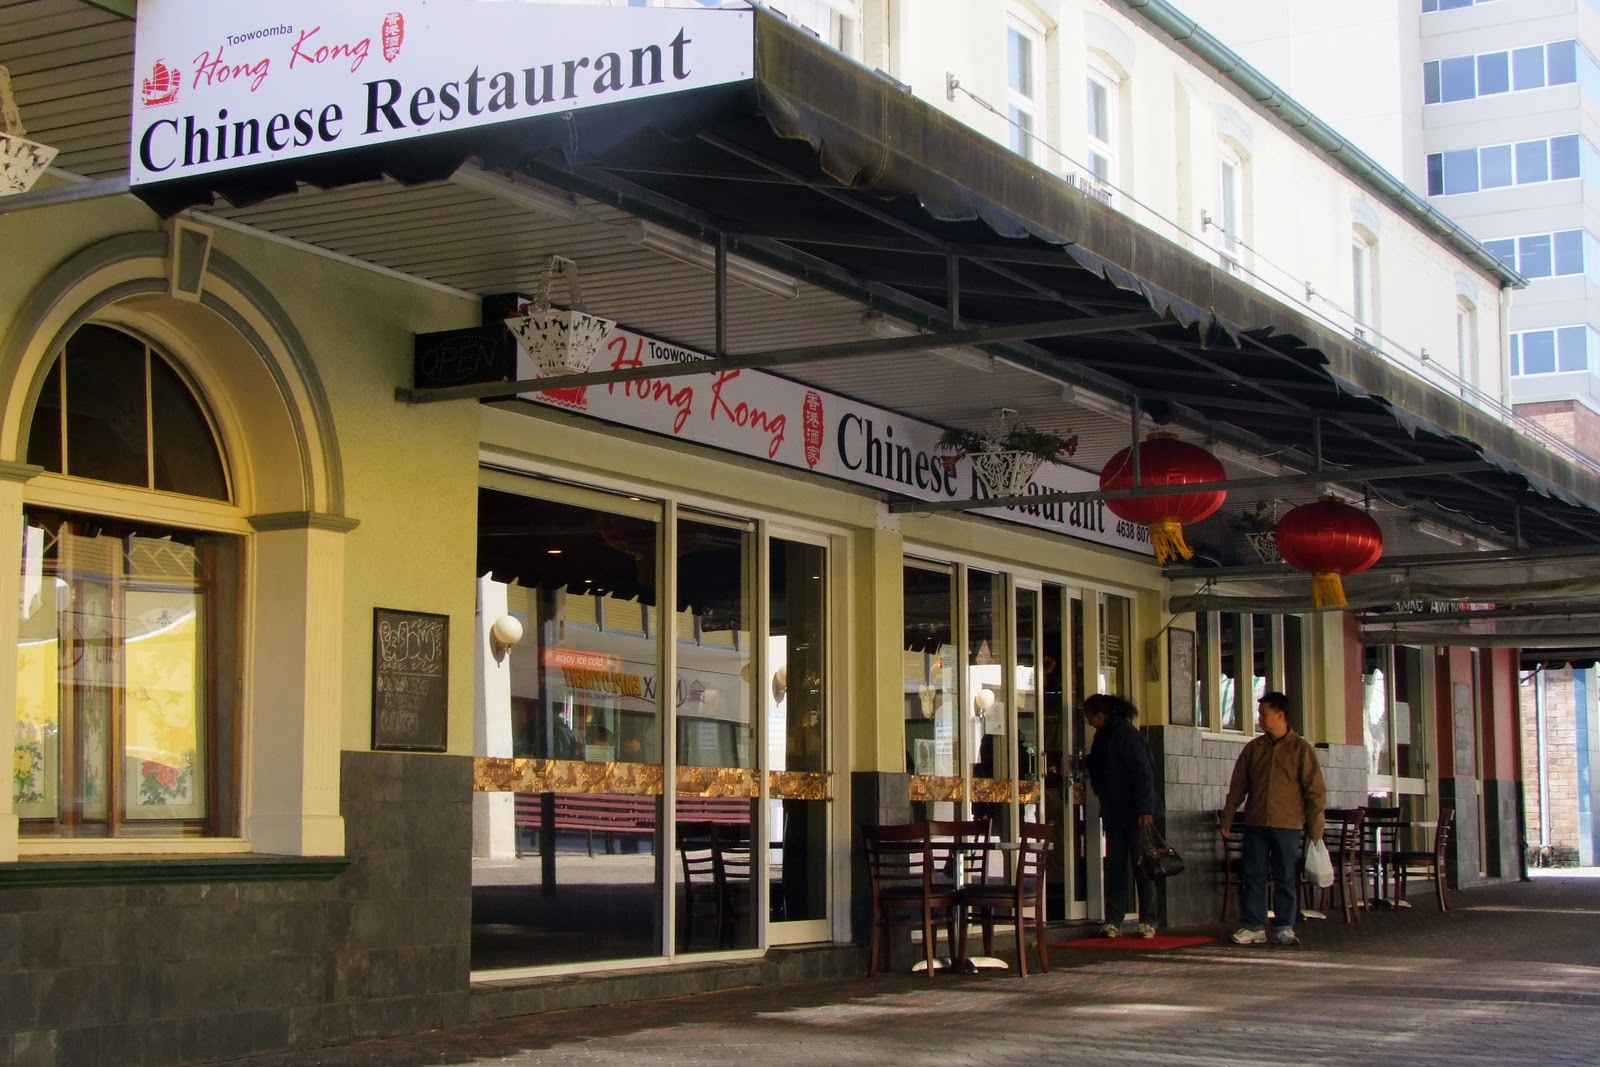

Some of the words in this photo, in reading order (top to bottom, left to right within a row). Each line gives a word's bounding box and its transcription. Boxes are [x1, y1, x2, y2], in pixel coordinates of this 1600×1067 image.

[192, 45, 272, 93] Hong
[288, 26, 372, 74] Kong
[226, 23, 294, 47] Toowoomba
[384, 12, 403, 60] 香港酒家
[139, 104, 344, 173] Chinese
[360, 26, 693, 136] Restaurant
[648, 341, 716, 376] Toowoo
[607, 336, 692, 433] Hong
[711, 369, 787, 458] Kong
[804, 393, 822, 463] 香港酒家
[837, 413, 957, 497] Chinese
[970, 461, 1105, 533] aurant
[1116, 520, 1135, 540] 4638
[1137, 525, 1156, 544] 807
[556, 653, 576, 666] enjoy
[577, 656, 587, 666] ice
[588, 657, 603, 667] cold
